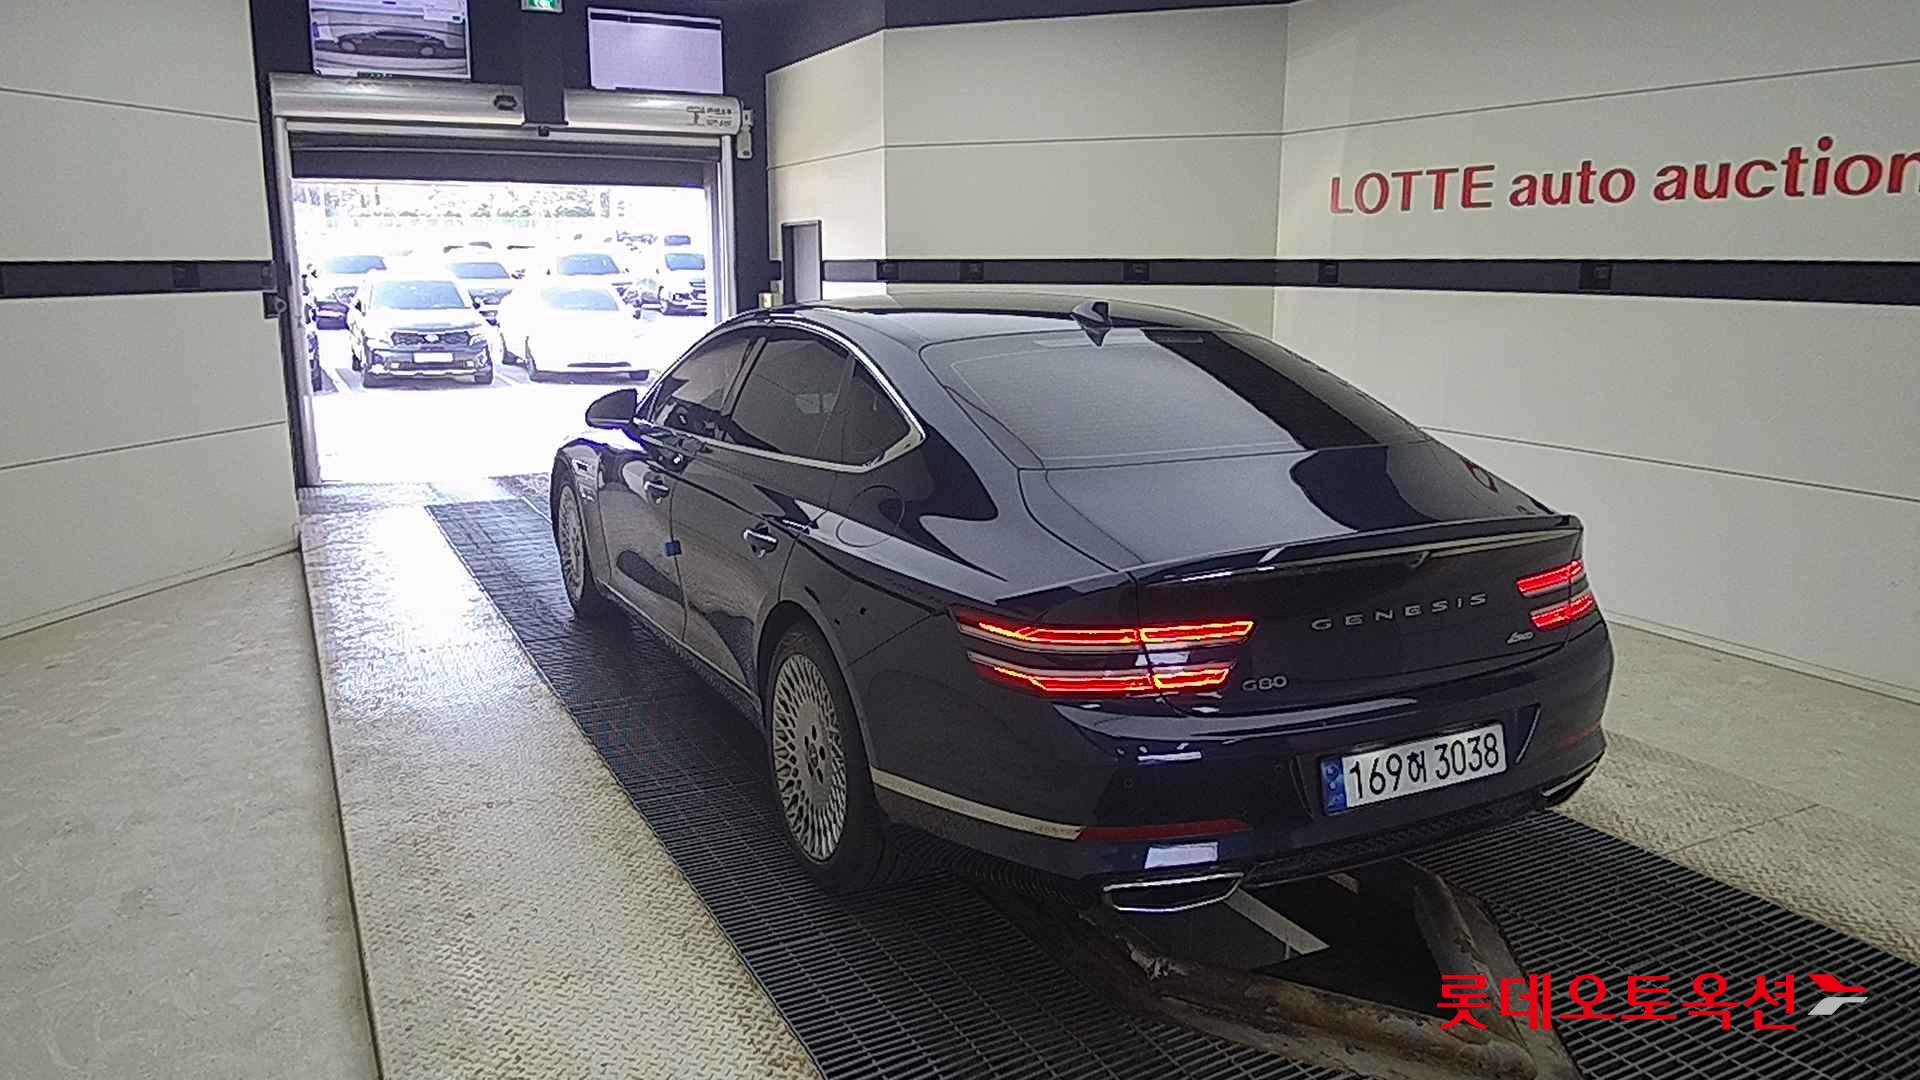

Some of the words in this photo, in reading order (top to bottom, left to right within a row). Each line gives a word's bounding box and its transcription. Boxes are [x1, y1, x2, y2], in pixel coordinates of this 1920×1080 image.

[1331, 165, 1494, 213] LOTTE
[1510, 161, 1635, 207] auto
[1311, 594, 1487, 631] GENESIS
[1242, 676, 1288, 692] G80
[1433, 733, 1501, 781] 3038
